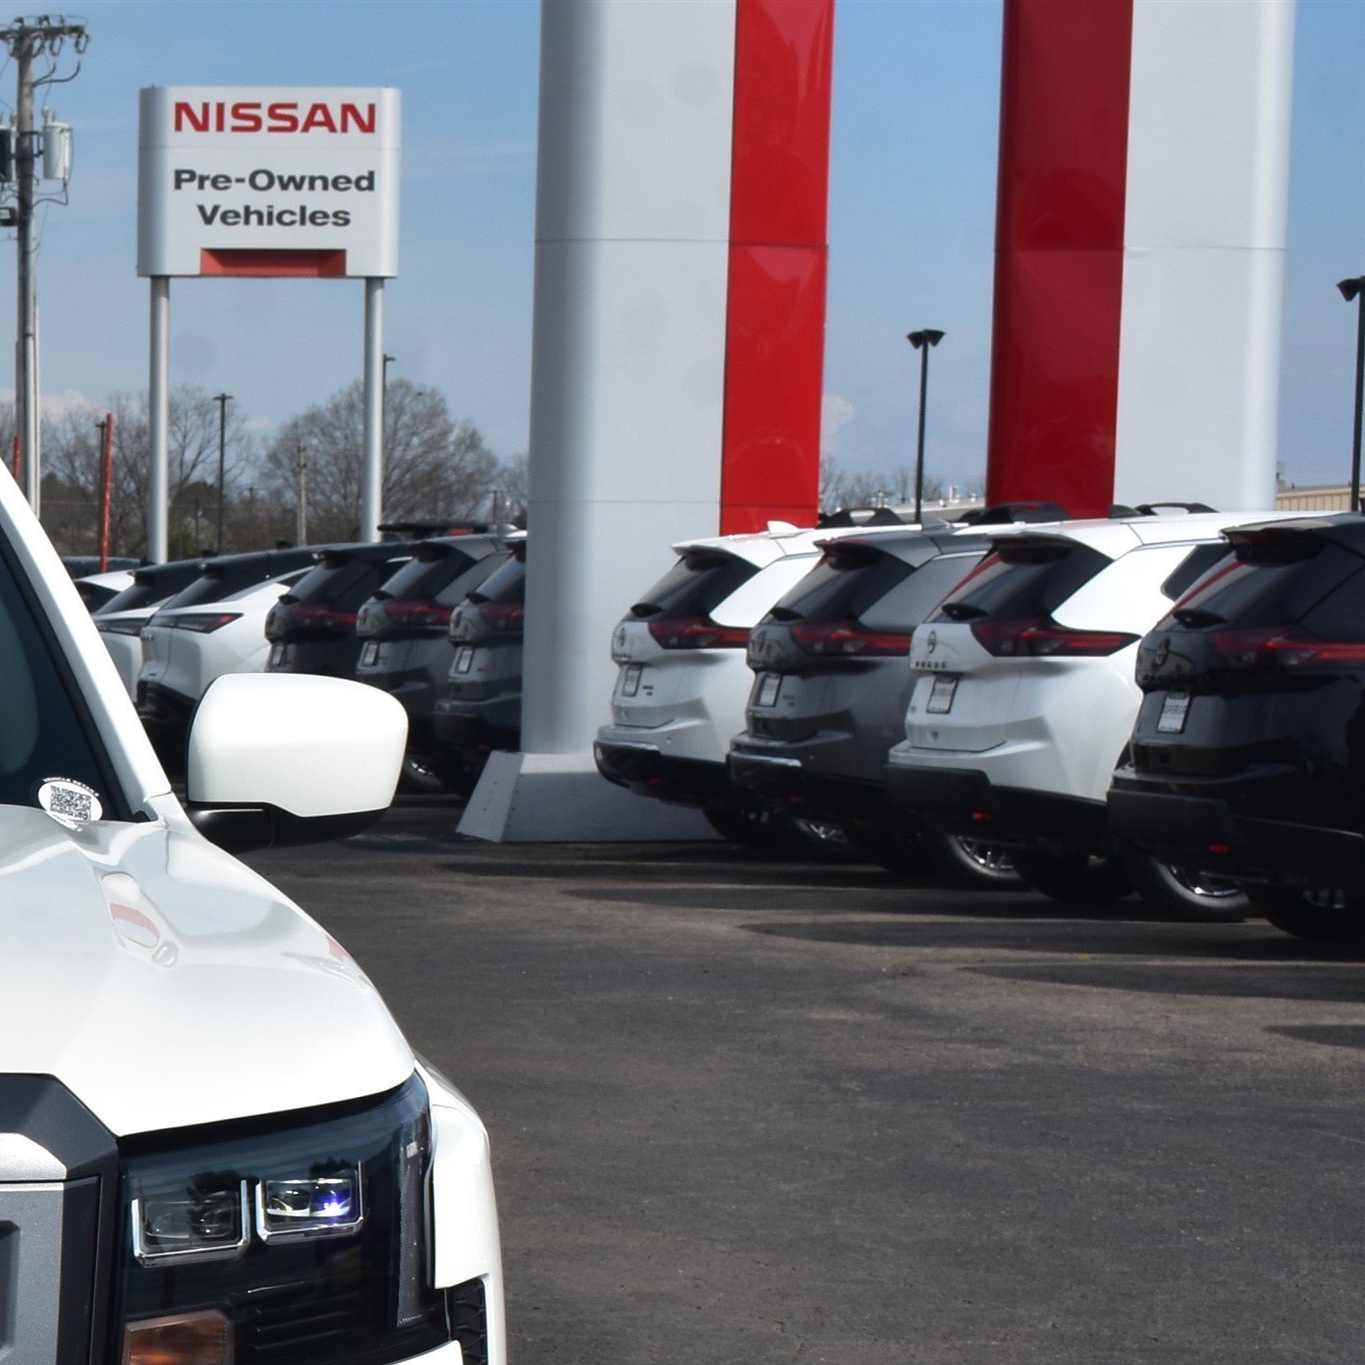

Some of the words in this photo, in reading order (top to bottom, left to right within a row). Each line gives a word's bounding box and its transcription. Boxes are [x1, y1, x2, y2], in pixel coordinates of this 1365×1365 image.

[174, 101, 376, 133] NISSAN
[173, 168, 375, 192] Pre-Owned
[196, 203, 351, 227] Vehicles
